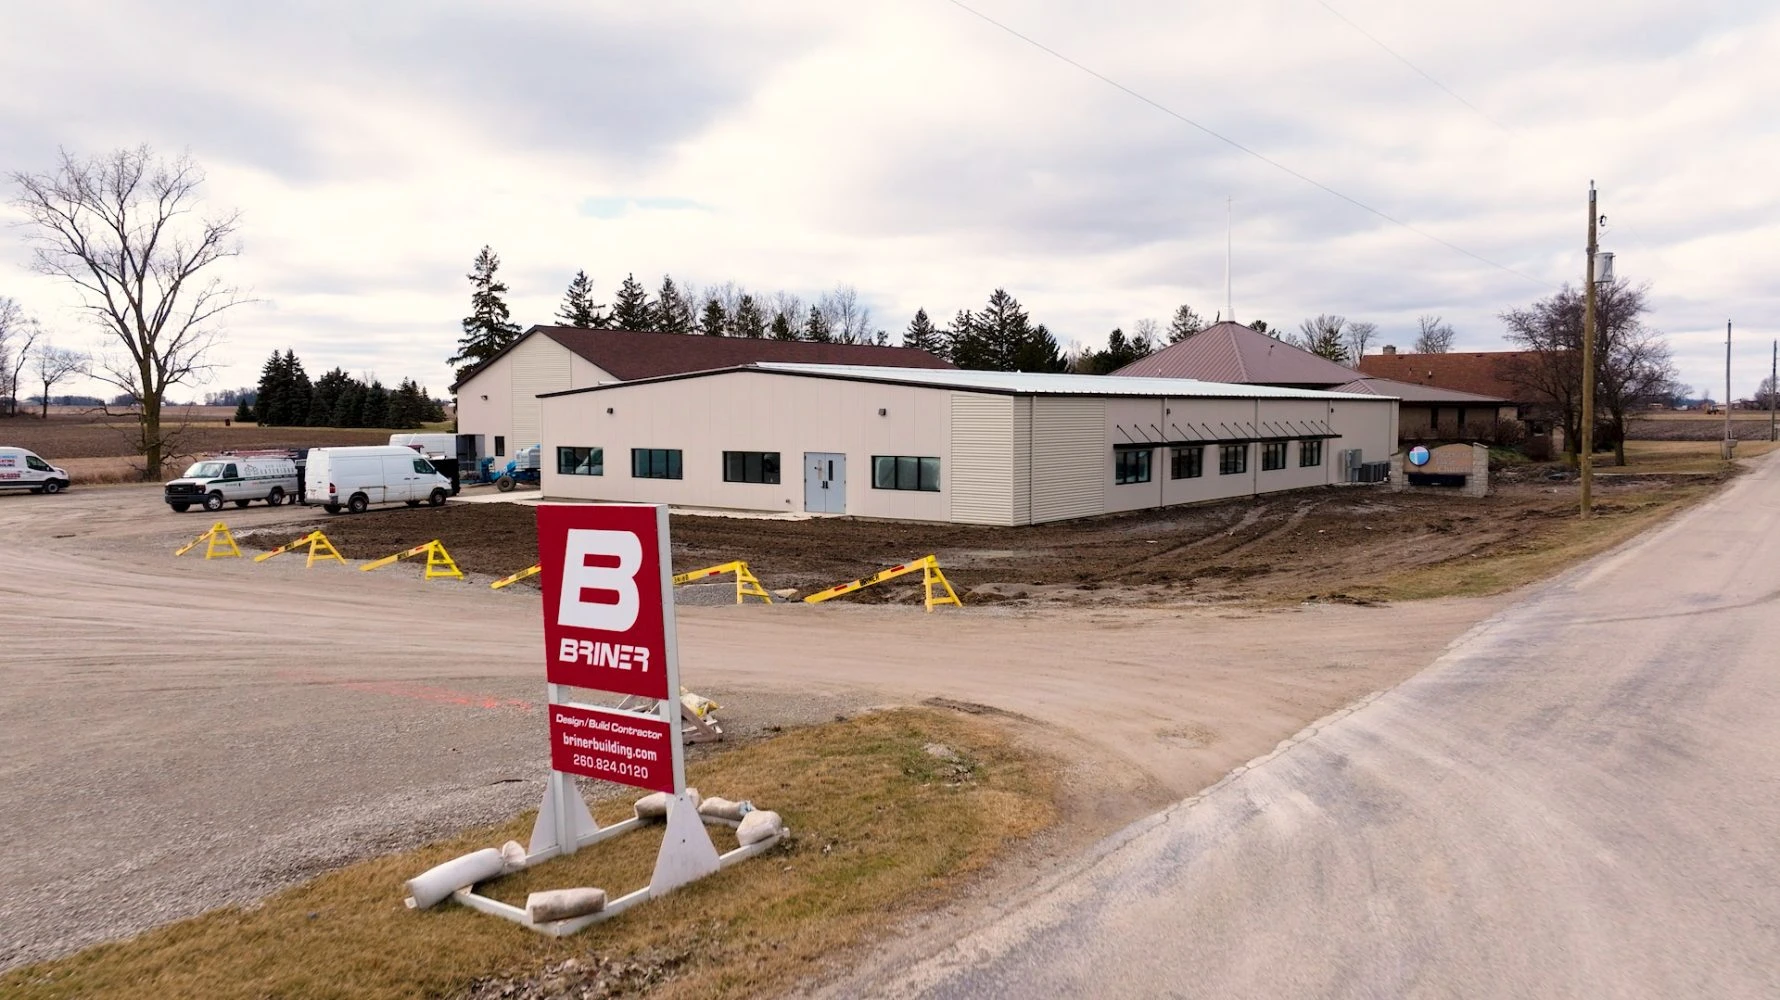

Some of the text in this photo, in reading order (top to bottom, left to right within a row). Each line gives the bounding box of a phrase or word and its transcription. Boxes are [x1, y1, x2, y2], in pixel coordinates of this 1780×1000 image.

[557, 528, 642, 632] B
[559, 638, 650, 672] BRINER
[556, 713, 662, 740] Design/Build Contractor
[563, 732, 657, 761] brinerbuilding.com
[573, 753, 648, 779] 260.824.0120
